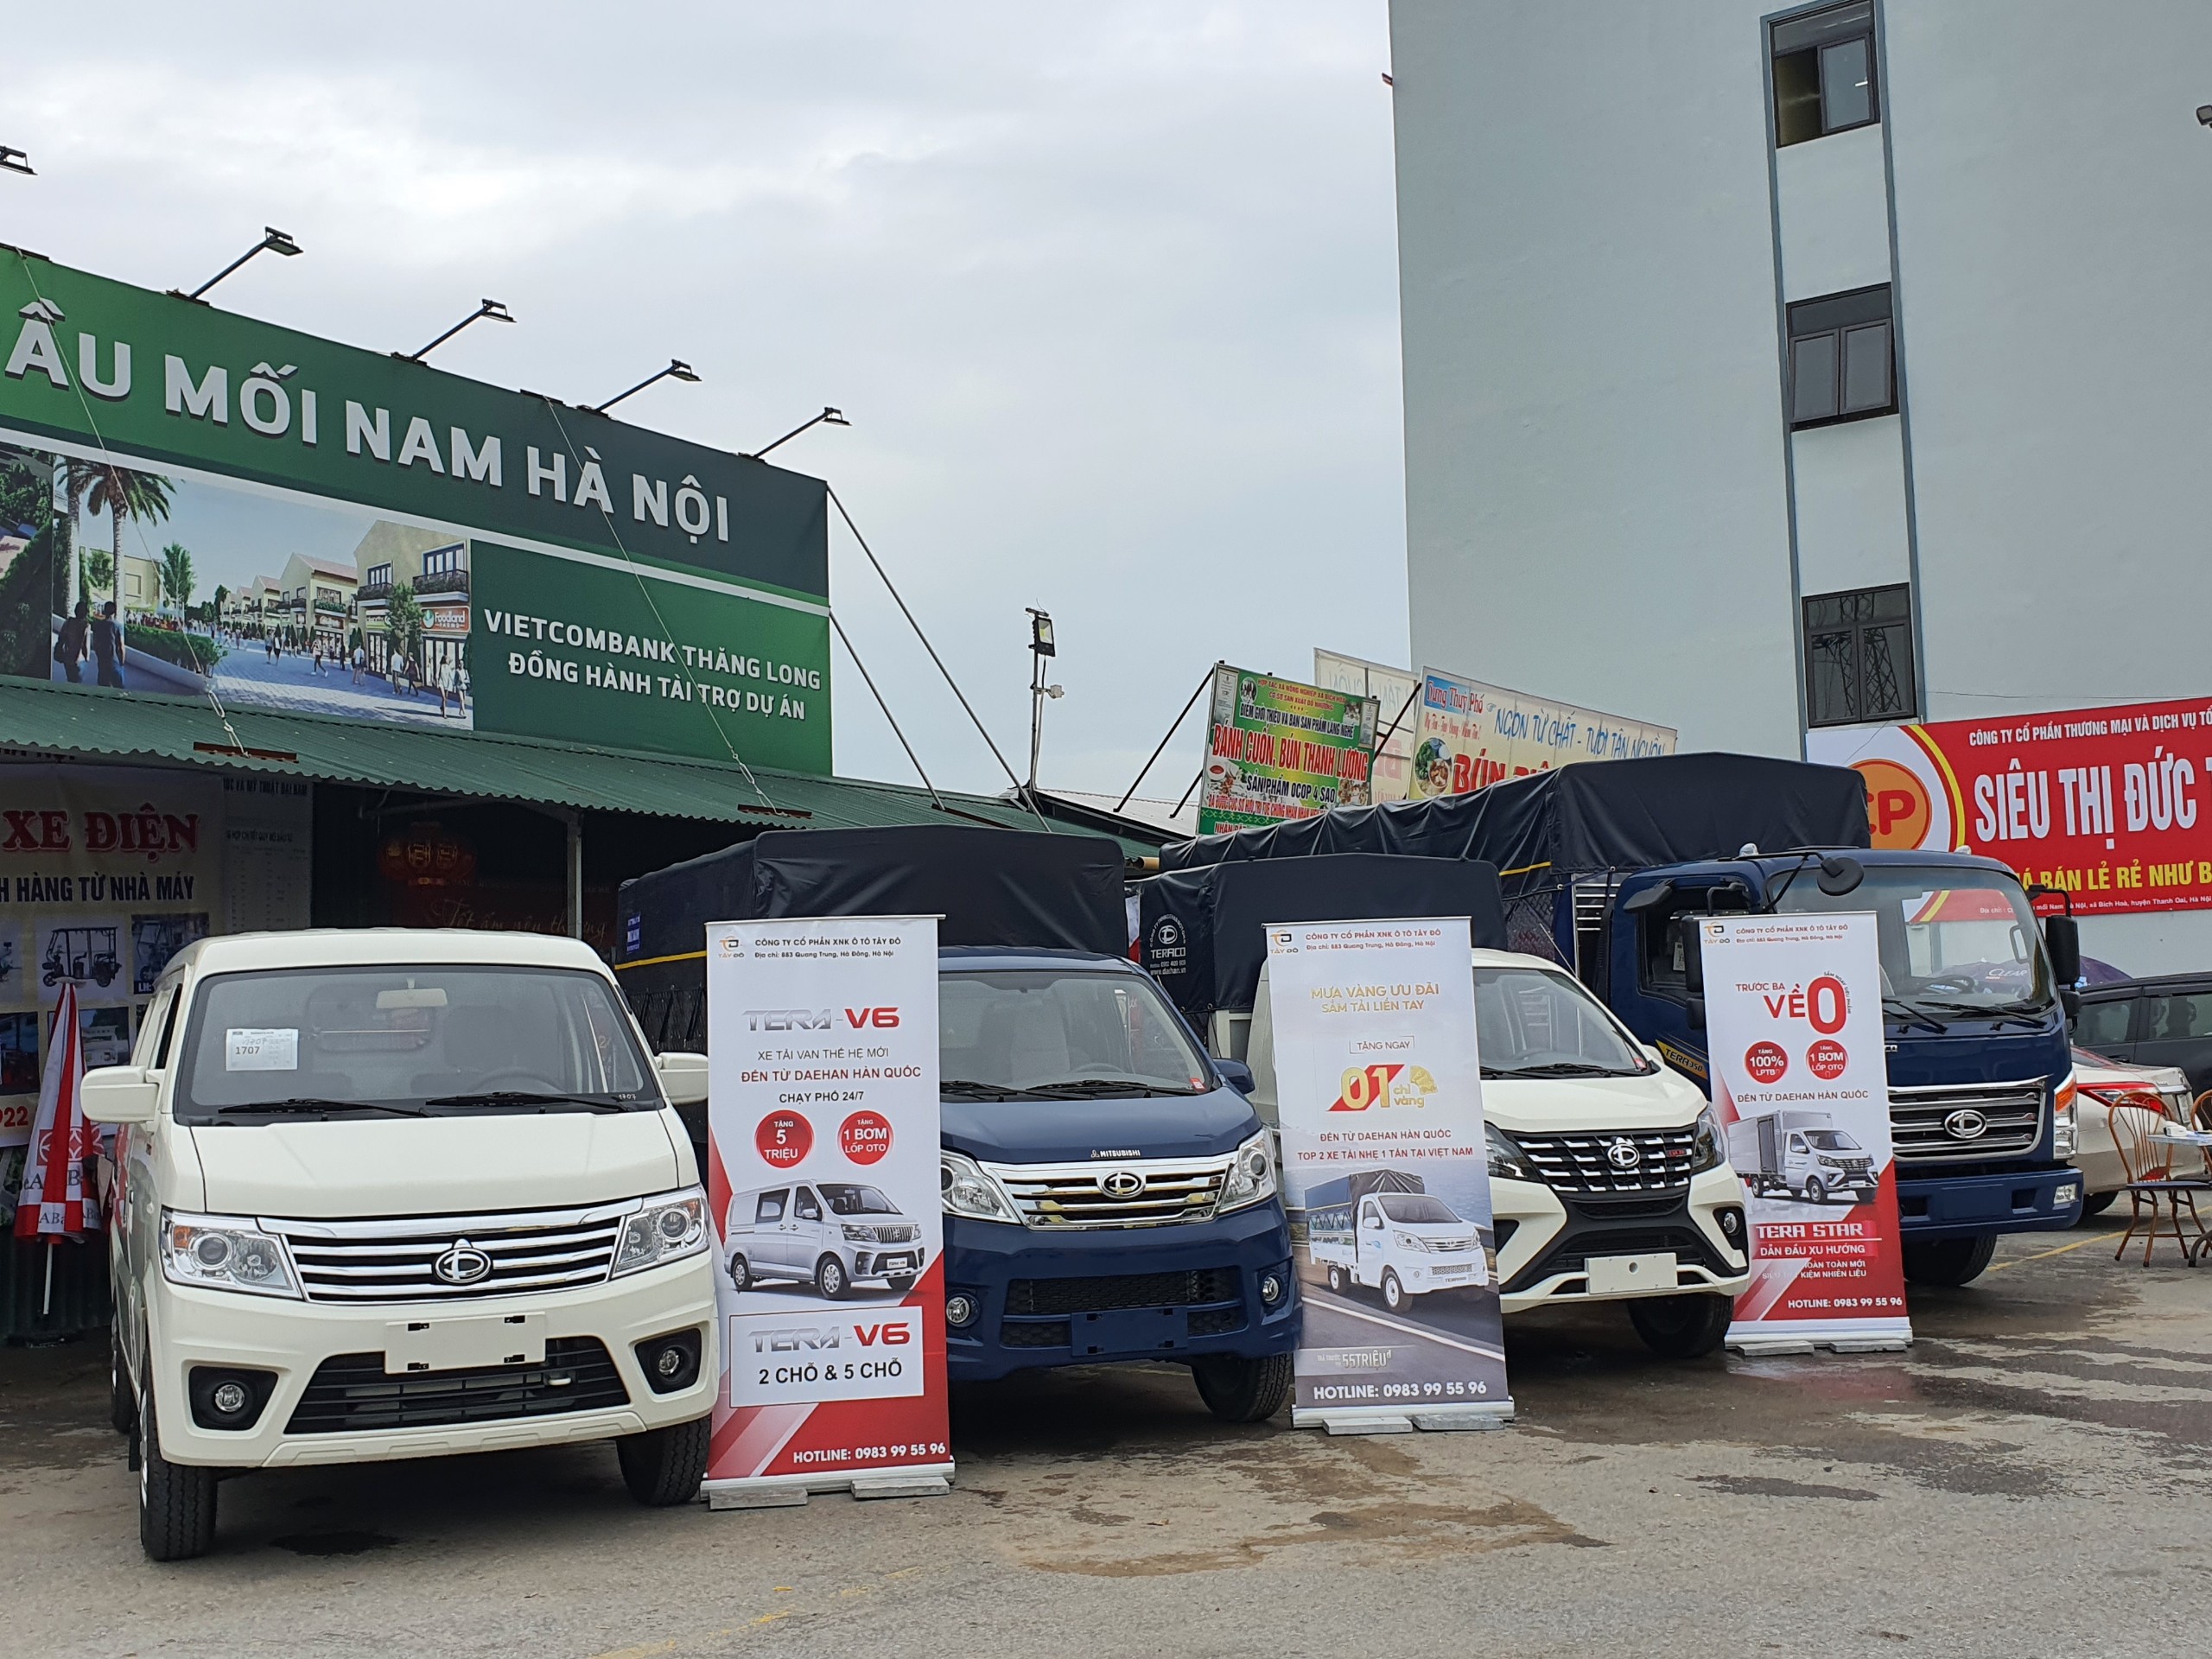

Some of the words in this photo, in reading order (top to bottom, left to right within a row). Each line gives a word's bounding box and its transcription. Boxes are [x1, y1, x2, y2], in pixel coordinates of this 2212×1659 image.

[165, 353, 317, 444] MỐI
[346, 400, 502, 486] NAM
[527, 446, 614, 513] HÀ
[632, 474, 728, 543] NỘI
[435, 610, 465, 623] Foodland
[484, 608, 677, 664] VIETCOMBANK
[682, 636, 760, 679] THĂNG
[766, 660, 821, 690] LONG
[509, 649, 578, 683] ĐỒNG
[586, 662, 651, 695] HÀNH
[658, 671, 692, 701] TÀI
[697, 683, 741, 713] TRỢ
[747, 690, 775, 718] DỰ
[779, 694, 804, 719] ÁN
[1969, 728, 1997, 747] CÔNG
[2000, 728, 2013, 744] TY
[2015, 721, 2030, 743] CỔ
[2032, 721, 2063, 741] PHẦN
[2065, 721, 2108, 739] THƯƠNG
[2111, 719, 2132, 738] MẠI
[2133, 715, 2149, 732] VÀ
[2152, 713, 2179, 731] DỊCH
[2181, 713, 2196, 729] VỤ
[1212, 719, 1243, 760] BÁNH
[1279, 733, 1301, 769] BÚN
[1303, 742, 1336, 776] THANH
[1247, 770, 1263, 792] SẢN
[1266, 774, 1288, 796] PHẨM
[1291, 783, 1311, 799] OCOP
[1313, 786, 1319, 799] 4
[1320, 787, 1336, 804] SAO
[1974, 758, 2050, 842] SIÊU
[2058, 766, 2114, 849] THỊ
[2123, 746, 2197, 833] ĐỨC
[2, 810, 70, 852] XE
[85, 804, 199, 862] ĐIỆN
[2040, 866, 2082, 892] BÁN
[2088, 861, 2111, 890] LẺ
[2116, 859, 2143, 888] RẺ
[2148, 861, 2194, 887] NHƯ
[16, 871, 73, 903] HÀNG
[78, 868, 106, 900] TỪ
[111, 870, 151, 900] NHÀ
[156, 868, 194, 900] MÁY
[755, 938, 780, 946] CÔNG
[793, 936, 806, 946] CỔ
[808, 936, 830, 946] PHẦN
[873, 937, 887, 945] TÂY
[889, 937, 901, 945] ĐÔ
[1150, 947, 1186, 959] TERACO
[1311, 986, 1342, 999] MƯA
[1345, 983, 1387, 997] VÀNG
[1390, 982, 1413, 996] ƯU
[1415, 982, 1440, 995] ĐÃI
[1736, 982, 1770, 992] TRƯỚC
[1772, 982, 1786, 991] BẠ
[1402, 1000, 1424, 1010] TAY
[1763, 983, 1805, 1018] VỀ
[1808, 976, 1847, 1034] 0
[235, 1046, 260, 1055] 1707
[1385, 1040, 1411, 1050] NGAY
[758, 1052, 772, 1060] XE
[776, 1047, 793, 1060] TẢI
[798, 1051, 820, 1059] VAN
[823, 1048, 845, 1058] THẾ
[867, 1046, 889, 1057] MỚI
[1750, 1056, 1784, 1067] 100%
[741, 1068, 768, 1082] ĐẾN
[772, 1068, 791, 1082] TỪ
[795, 1070, 849, 1081] DAEHAN
[853, 1066, 880, 1078] HÀN
[884, 1065, 921, 1077] QUỐC
[1341, 1066, 1390, 1109] 01
[779, 1093, 811, 1104] CHẠY
[815, 1090, 839, 1103] PHỐ
[842, 1090, 864, 1102] 24/7
[1394, 1095, 1424, 1108] vàng
[776, 1130, 786, 1144] 5
[843, 1130, 850, 1140] 1
[854, 1128, 887, 1141] BƠM
[765, 1148, 798, 1160] TRIỆU
[845, 1142, 864, 1154] LỐP
[866, 1143, 887, 1152] OTO
[1100, 1149, 1141, 1158] MITSUBISHI
[1297, 1152, 1317, 1160] TOP
[1319, 1151, 1325, 1160] 2
[1326, 1151, 1339, 1160] XE
[1342, 1149, 1357, 1160] TẢI
[1359, 1149, 1378, 1160] NHẸ
[1389, 1147, 1408, 1158] TẤN
[1411, 1148, 1426, 1159] TẠI
[1428, 1147, 1449, 1158] VIỆT
[1452, 1147, 1473, 1156] NAM
[1756, 1224, 1806, 1239] TERA
[1813, 1223, 1864, 1237] STAR
[1760, 1244, 1782, 1255] DẪN
[1785, 1243, 1807, 1255] ĐẦU
[1808, 1245, 1823, 1255] XU
[1826, 1243, 1866, 1254] HƯỚNG
[1850, 1259, 1866, 1268] MỚI
[1801, 1269, 1821, 1280] KIỆM
[1822, 1269, 1847, 1278] NHIÊN
[1849, 1268, 1866, 1278] LIỆU
[759, 1369, 770, 1384] 2
[775, 1362, 818, 1383] CHỖ
[824, 1364, 838, 1380] &
[844, 1364, 854, 1379] 5
[860, 1357, 902, 1378] CHỖ
[793, 1448, 851, 1463] HOTLINE:
[855, 1446, 887, 1459] 0983
[890, 1444, 907, 1458] 99
[910, 1443, 926, 1456] 55
[930, 1442, 946, 1455] 96
